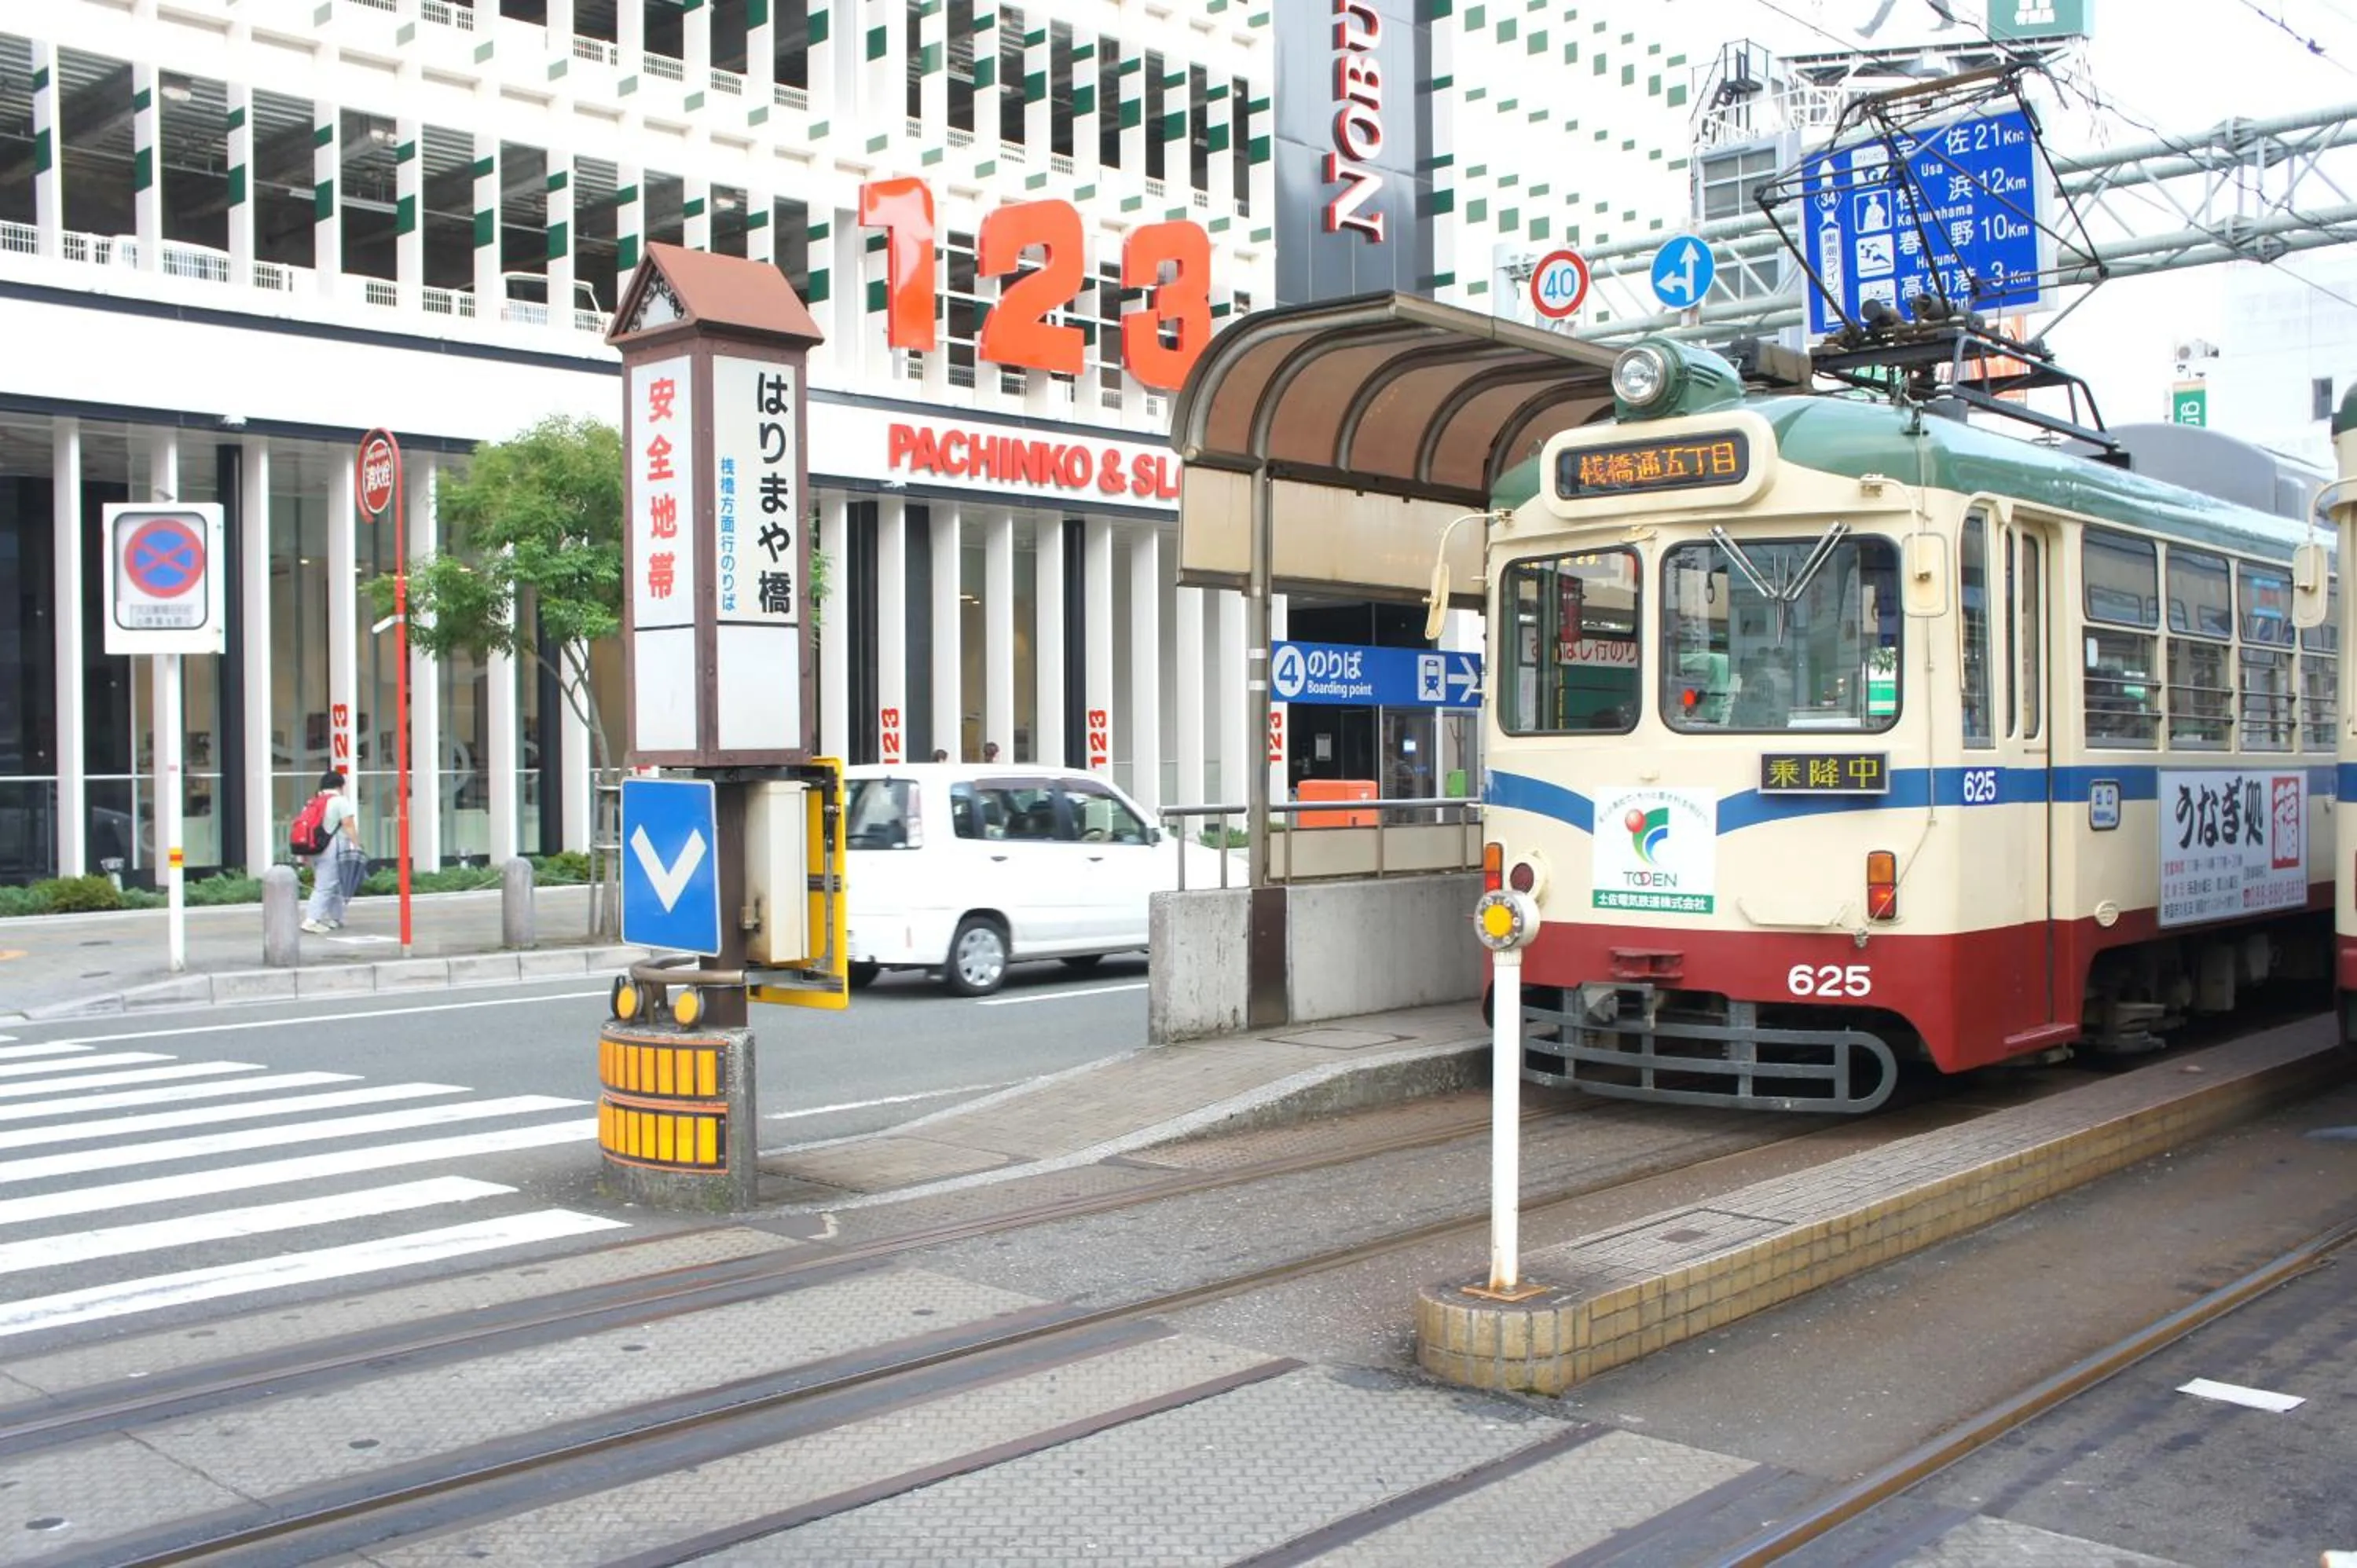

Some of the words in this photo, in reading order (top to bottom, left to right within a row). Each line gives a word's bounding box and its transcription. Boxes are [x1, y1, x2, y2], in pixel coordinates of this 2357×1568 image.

[1921, 163, 1943, 177] Usa
[1820, 191, 1836, 207] 34
[858, 176, 1211, 391] 123
[1545, 268, 1575, 299] 40
[889, 423, 1093, 489] PACHINKO
[1098, 449, 1126, 494] &
[1132, 453, 1181, 499] SL
[647, 377, 677, 599] 安全地帯
[757, 372, 791, 614] はりまや橋
[1307, 650, 1363, 680] のりば
[1307, 680, 1347, 698] Boarding
[1349, 682, 1373, 698] point
[1088, 709, 1107, 768] 123
[1768, 757, 1879, 788] 乗降中
[1963, 770, 1996, 802] 625
[1787, 964, 1871, 997] 625
